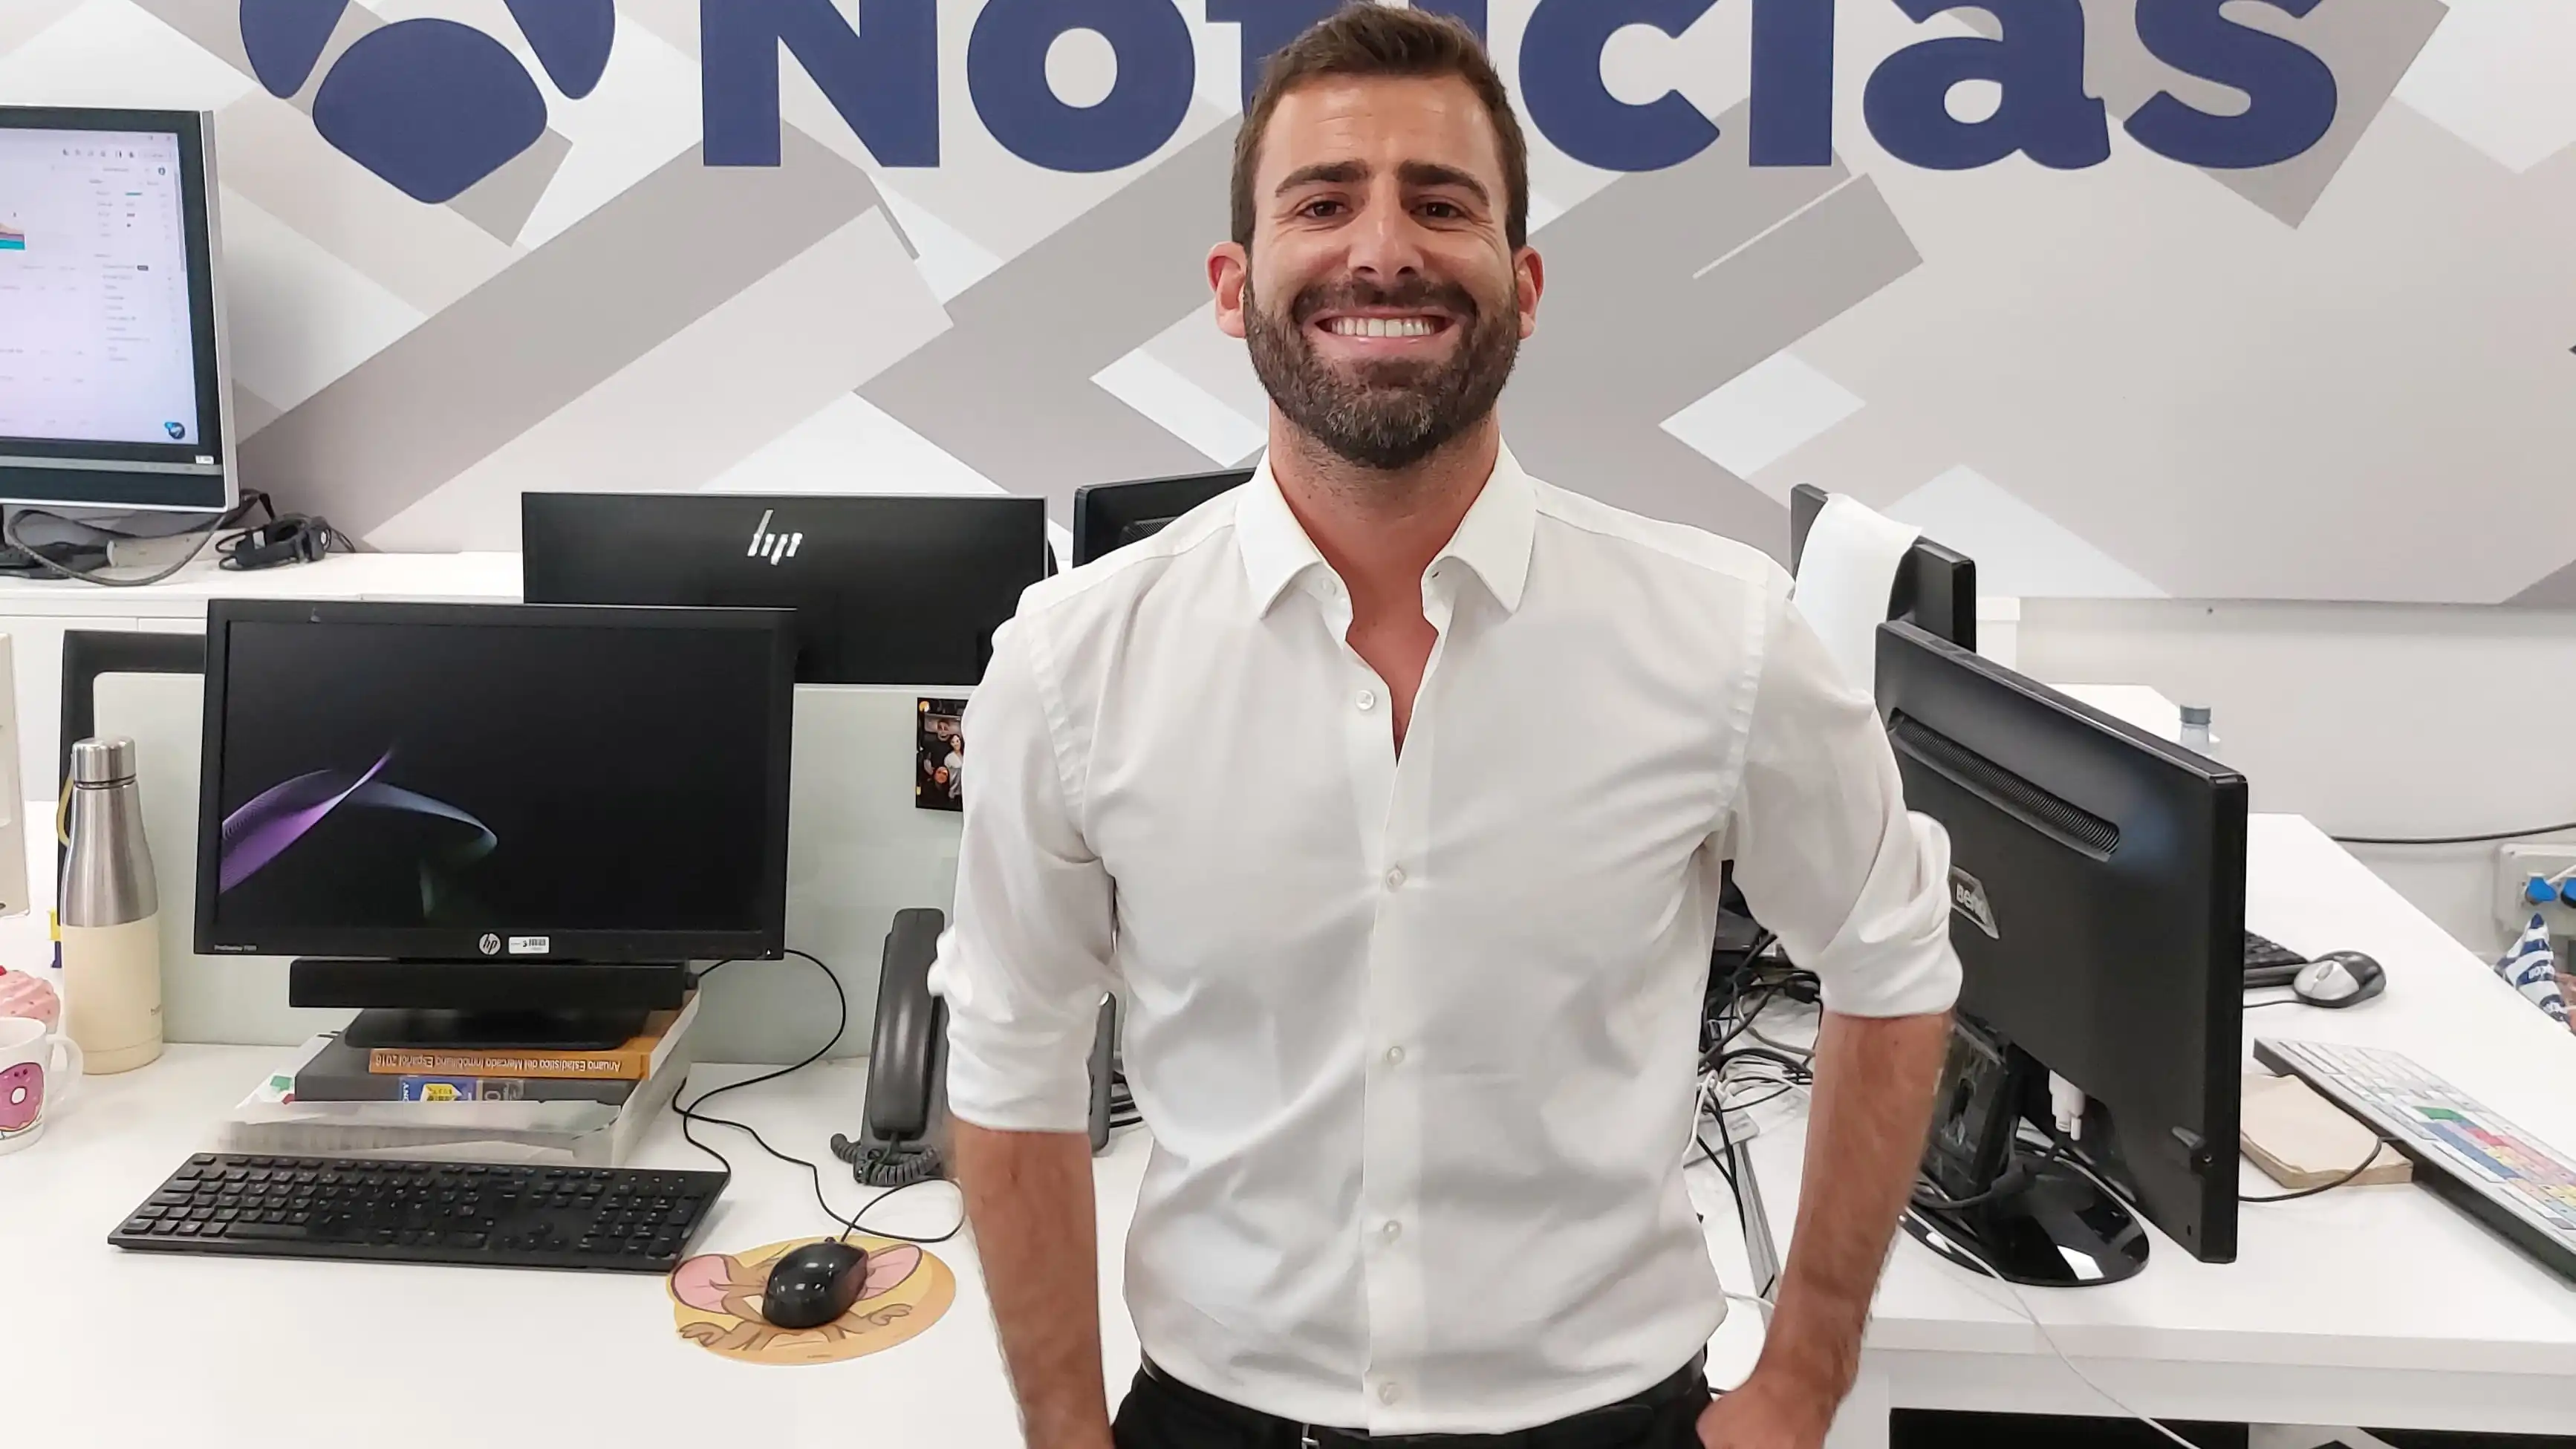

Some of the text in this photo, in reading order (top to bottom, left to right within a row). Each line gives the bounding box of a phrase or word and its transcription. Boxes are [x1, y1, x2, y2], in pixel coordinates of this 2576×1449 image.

[700, 0, 2337, 172] Nocias
[747, 509, 803, 565] hp
[481, 934, 498, 954] hp
[486, 1058, 523, 1071] Mercado
